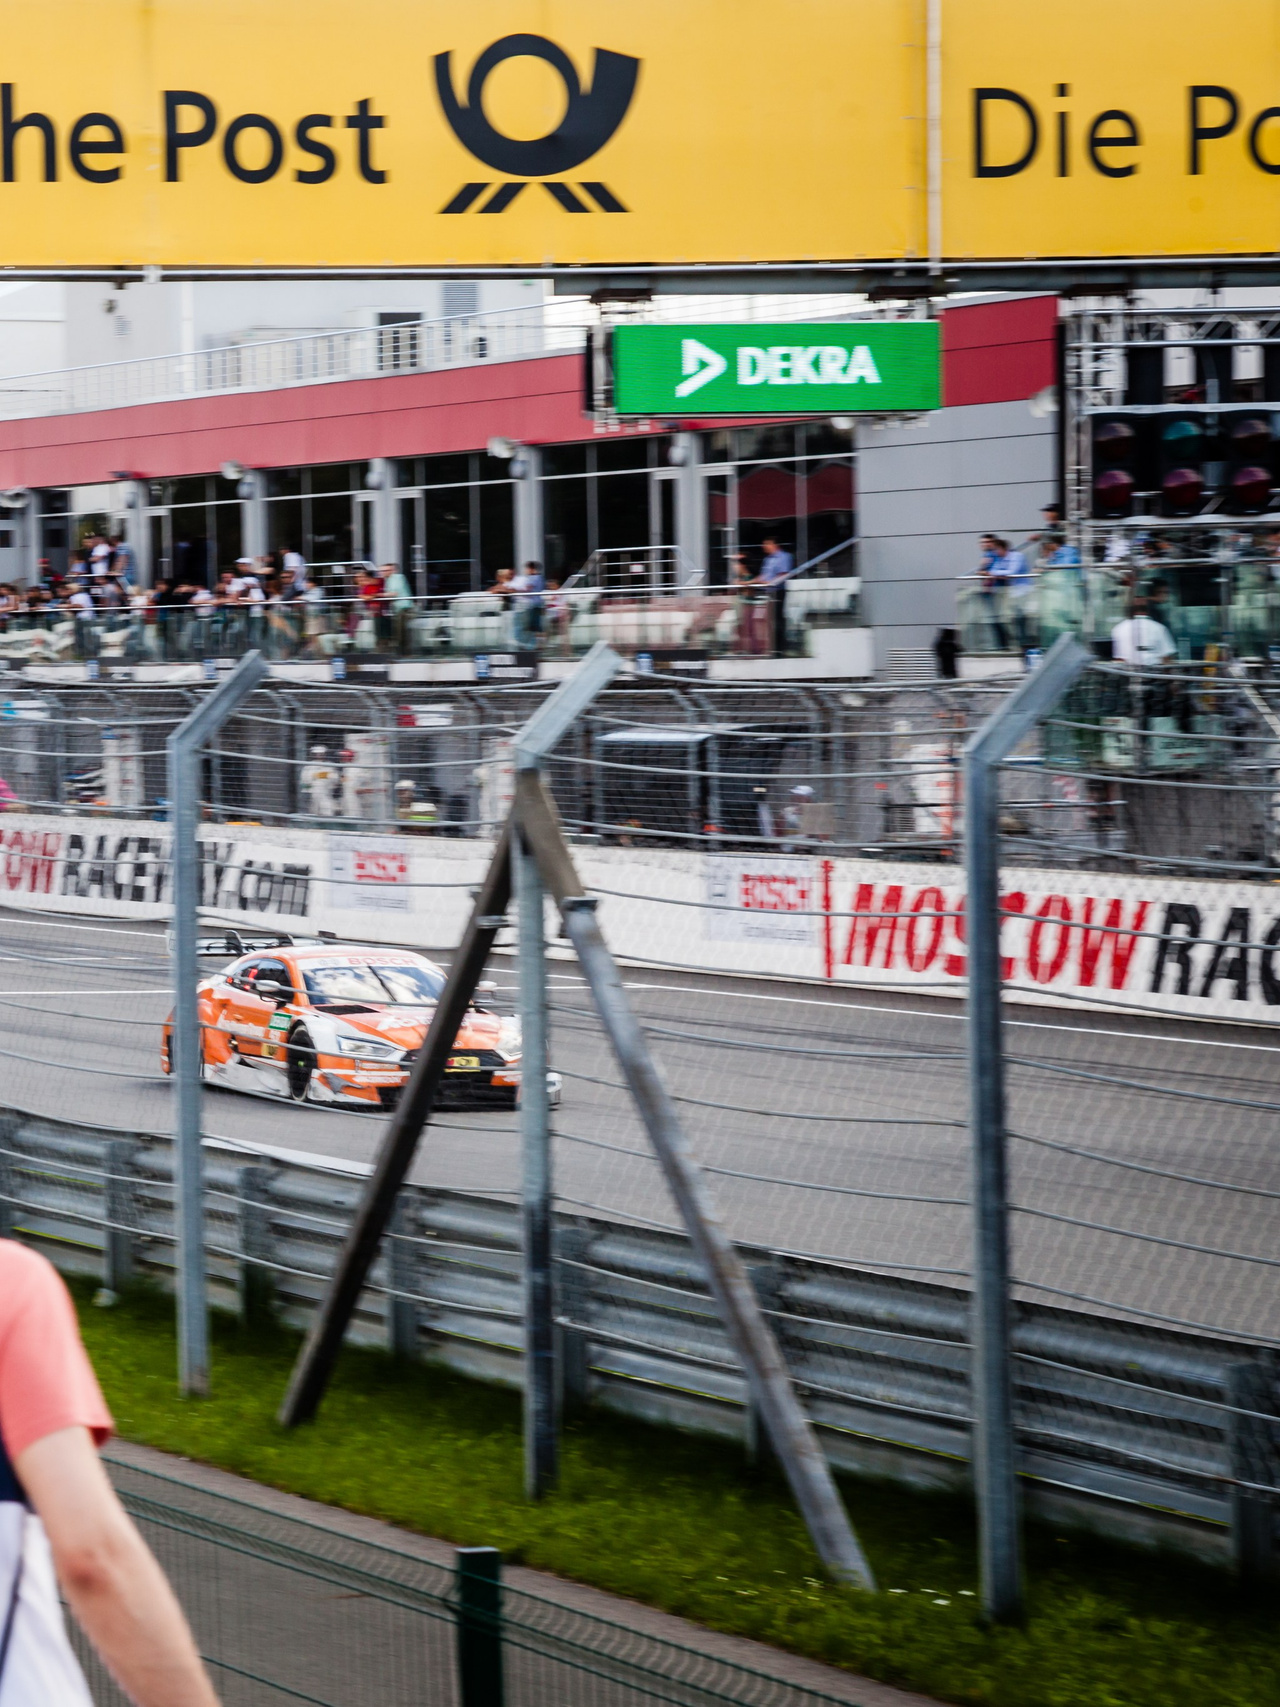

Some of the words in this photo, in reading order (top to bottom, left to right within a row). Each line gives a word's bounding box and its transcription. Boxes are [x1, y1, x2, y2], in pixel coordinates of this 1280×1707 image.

[161, 90, 389, 184] Post
[971, 82, 1143, 178] Die
[736, 345, 883, 385] DEKRA
[347, 957, 417, 967] BOSCH
